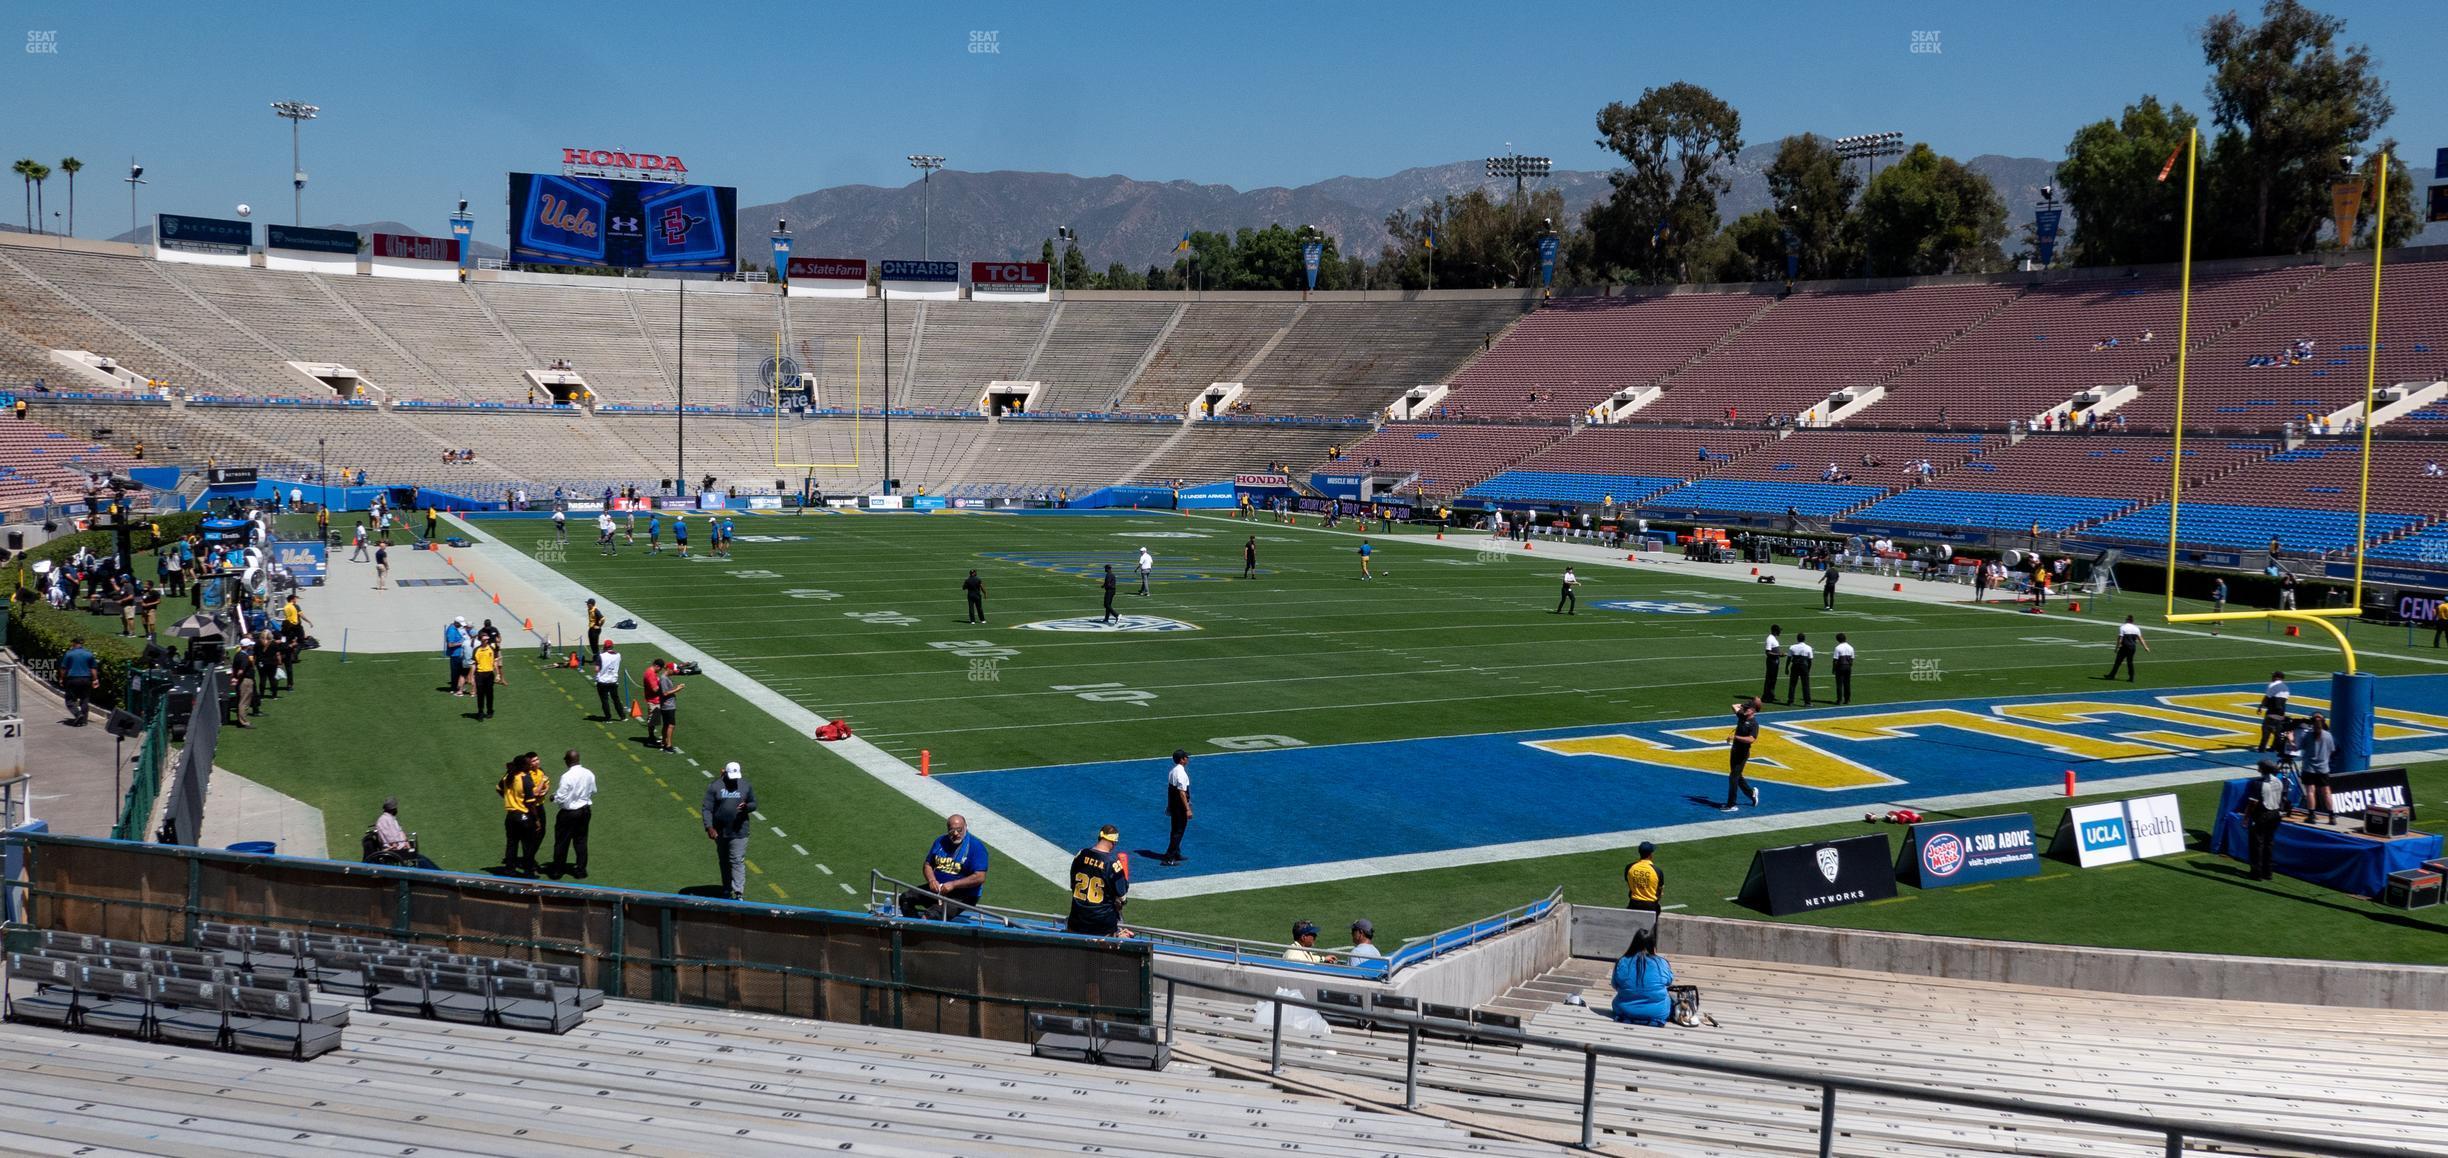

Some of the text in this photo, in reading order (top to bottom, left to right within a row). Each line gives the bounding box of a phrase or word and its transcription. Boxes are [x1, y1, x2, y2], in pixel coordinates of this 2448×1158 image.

[562, 147, 689, 172] HONDA
[540, 194, 597, 238] Ucla
[883, 262, 957, 276] ONTARIO
[986, 265, 1035, 281] TCL
[1235, 475, 1287, 485] HONDA
[1327, 477, 1346, 485] MUSCLE
[1298, 498, 1320, 511] CENTURY
[281, 548, 317, 565] Ucla
[2394, 573, 2426, 581] ARMOUR
[4, 724, 21, 738] 21
[2086, 815, 2176, 844] UCLA Health
[1965, 836, 1974, 853] A
[1975, 833, 1996, 851] SUB
[1928, 840, 1958, 857] Jersey
[1083, 856, 1106, 870] UCLA
[1968, 853, 2034, 867] visit: jerseymikes.com
[1825, 865, 1835, 876] 12
[1073, 872, 1105, 904] 26
[1805, 889, 1865, 907] NETWORKS
[750, 1083, 769, 1091] 10
[75, 1103, 96, 1111] 2
[782, 1111, 803, 1119] 10
[1007, 1111, 1028, 1119] 13
[178, 1117, 199, 1125] 3
[870, 1121, 891, 1129] 11
[1098, 1120, 1120, 1128] 14
[291, 1132, 311, 1141] 4
[513, 1128, 529, 1136] 6
[973, 1133, 995, 1141] 12
[73, 1146, 96, 1156] 2
[400, 1147, 419, 1156] 5
[618, 1143, 635, 1151] 7
[1081, 1145, 1104, 1153] 13
